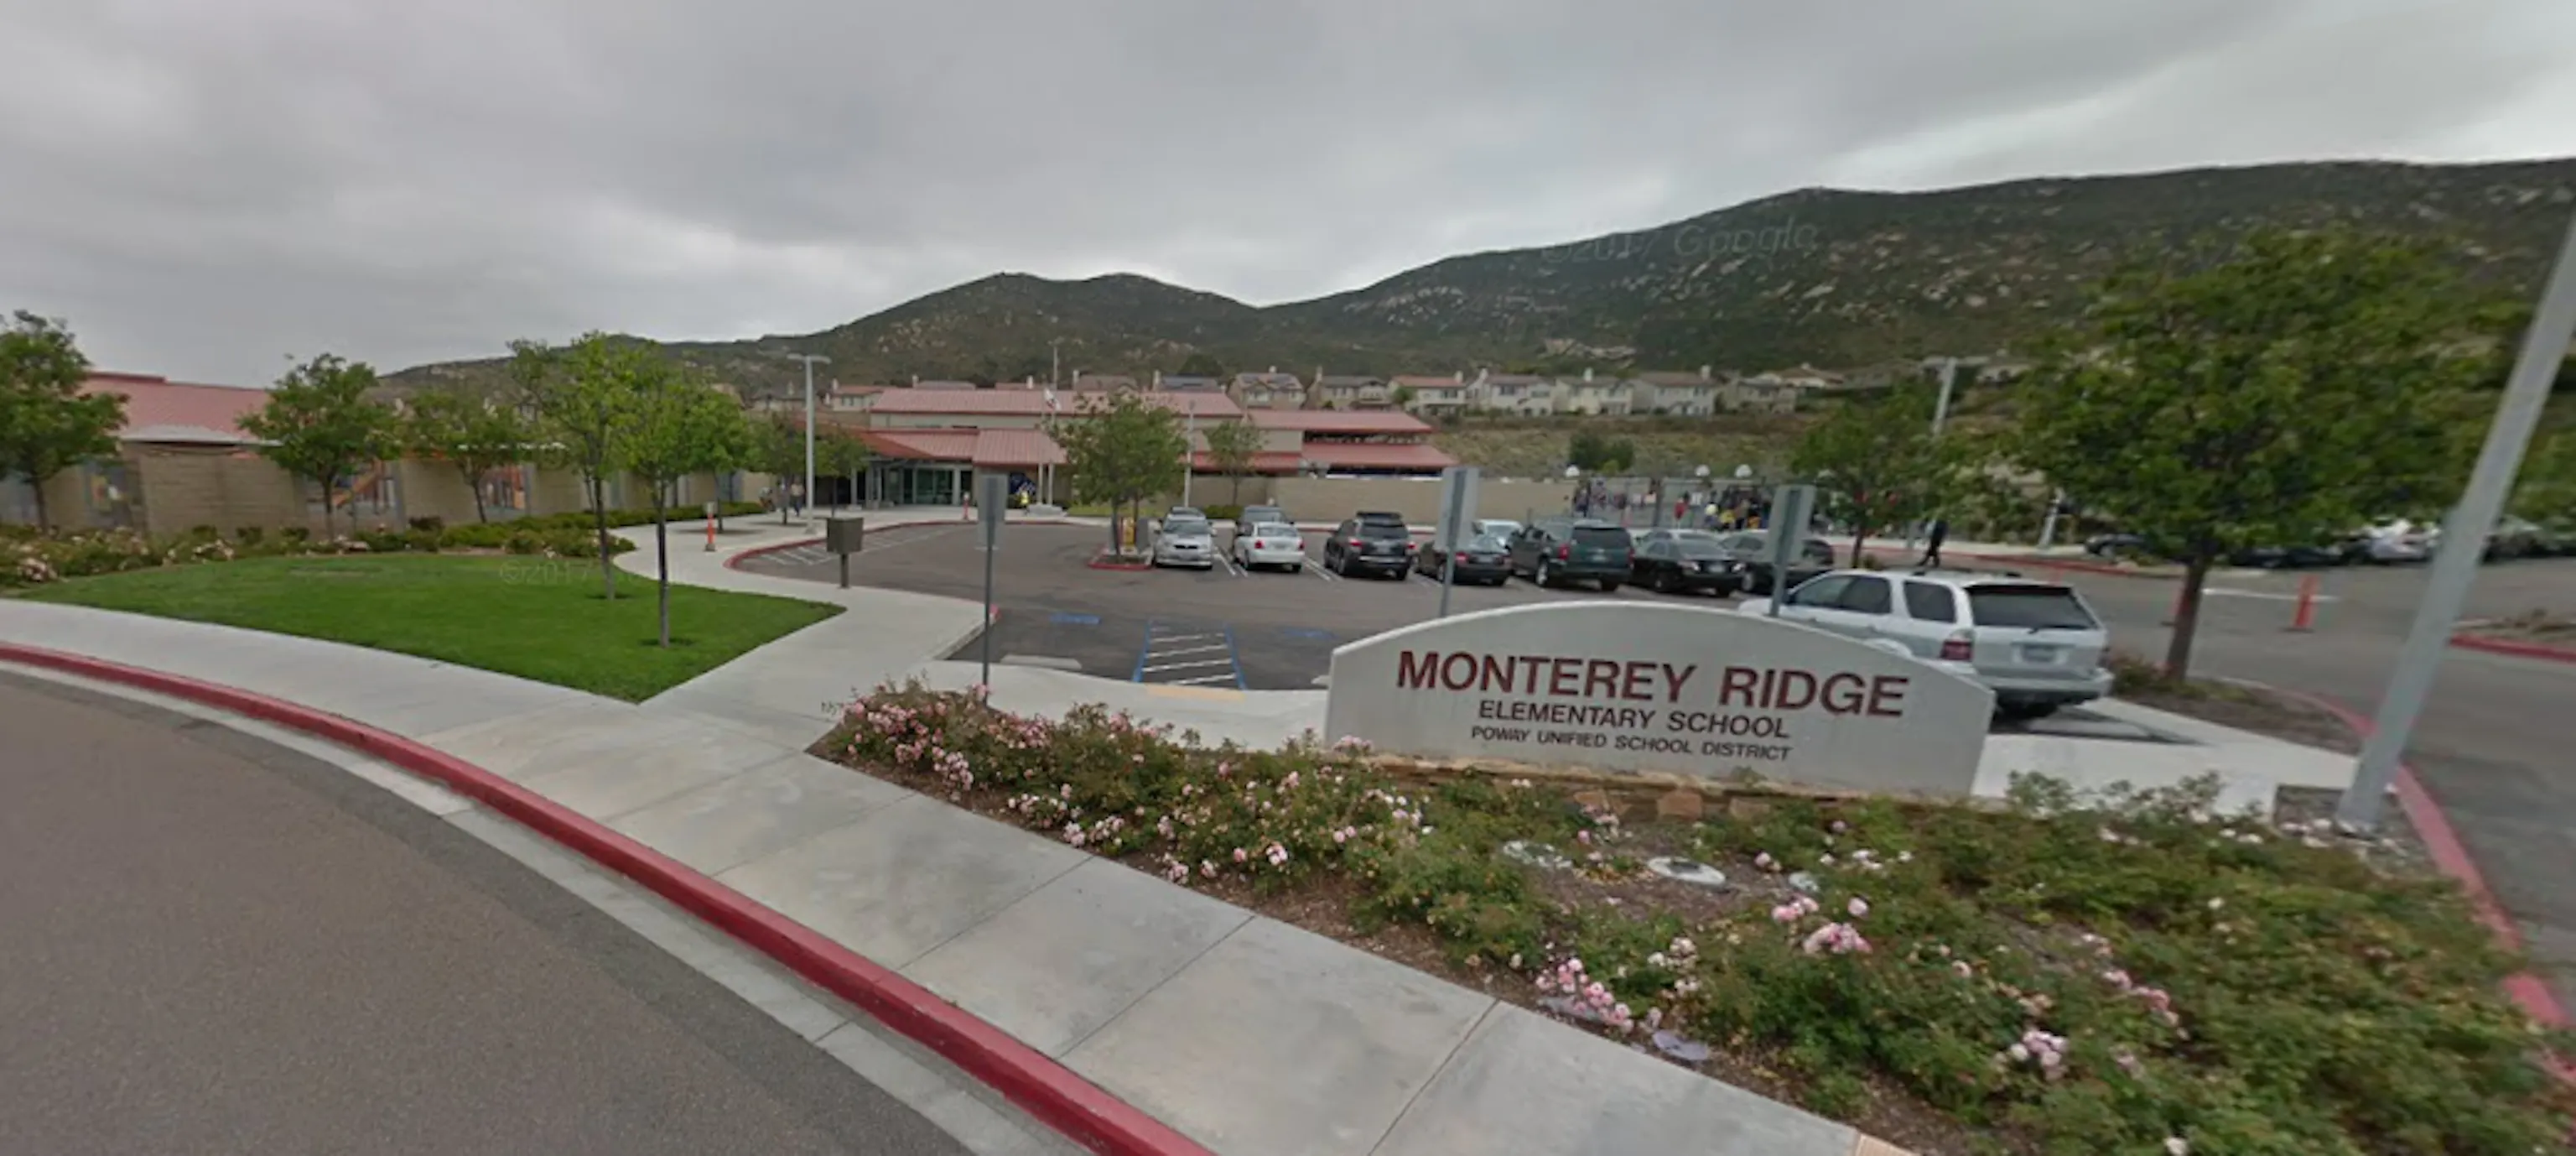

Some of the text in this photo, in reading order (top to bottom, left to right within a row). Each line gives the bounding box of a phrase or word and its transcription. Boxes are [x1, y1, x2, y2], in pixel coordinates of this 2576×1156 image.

[1396, 650, 1910, 717] MONTEREY RIDGE
[1478, 700, 1791, 738] ELEMENTARY SCHOOL
[1471, 725, 1794, 761] POWAY UNIFIED SCHOOL DISTRICT
